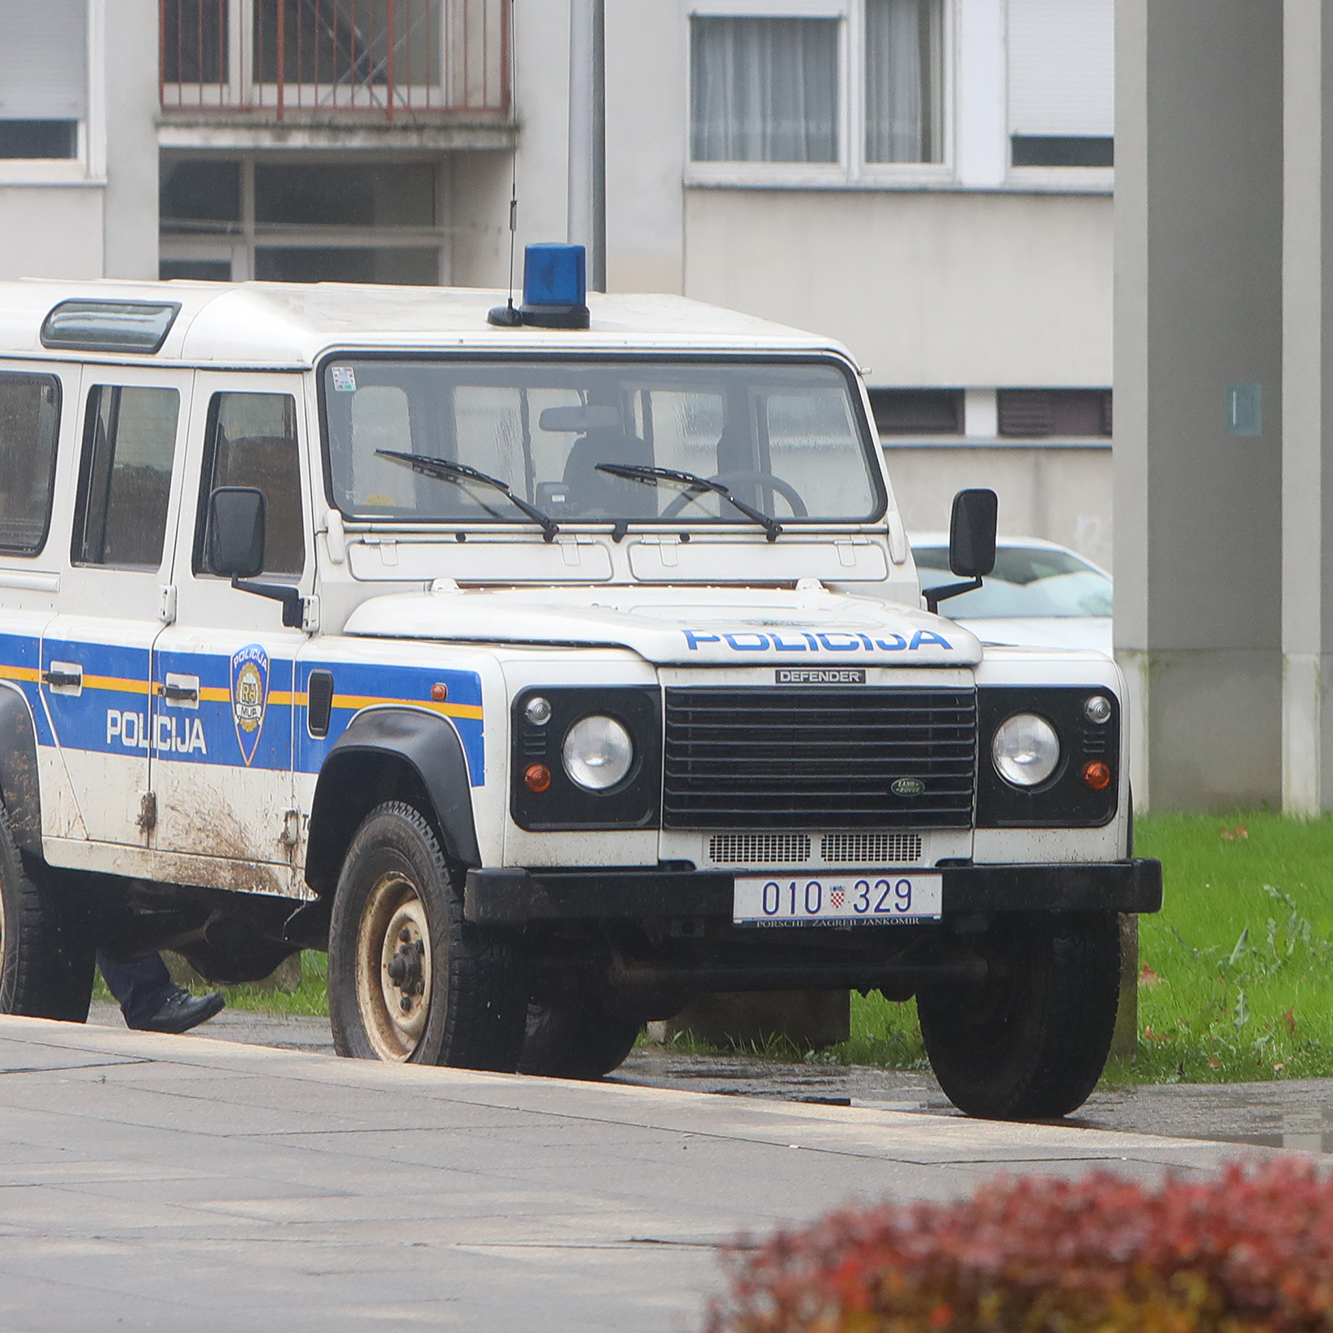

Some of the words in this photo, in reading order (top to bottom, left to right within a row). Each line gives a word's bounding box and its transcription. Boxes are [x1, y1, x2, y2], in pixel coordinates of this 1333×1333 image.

[681, 629, 954, 651] POLICIJA
[233, 648, 267, 672] POLICIJA
[779, 671, 860, 682] DEFENDER
[241, 706, 257, 718] MUP
[107, 709, 208, 754] POLICIJA
[762, 880, 822, 915] 010
[853, 878, 912, 914] 329
[756, 920, 806, 928] PORSCHE
[812, 919, 857, 927] ZAGREB
[862, 917, 919, 926] JANKOMIR
